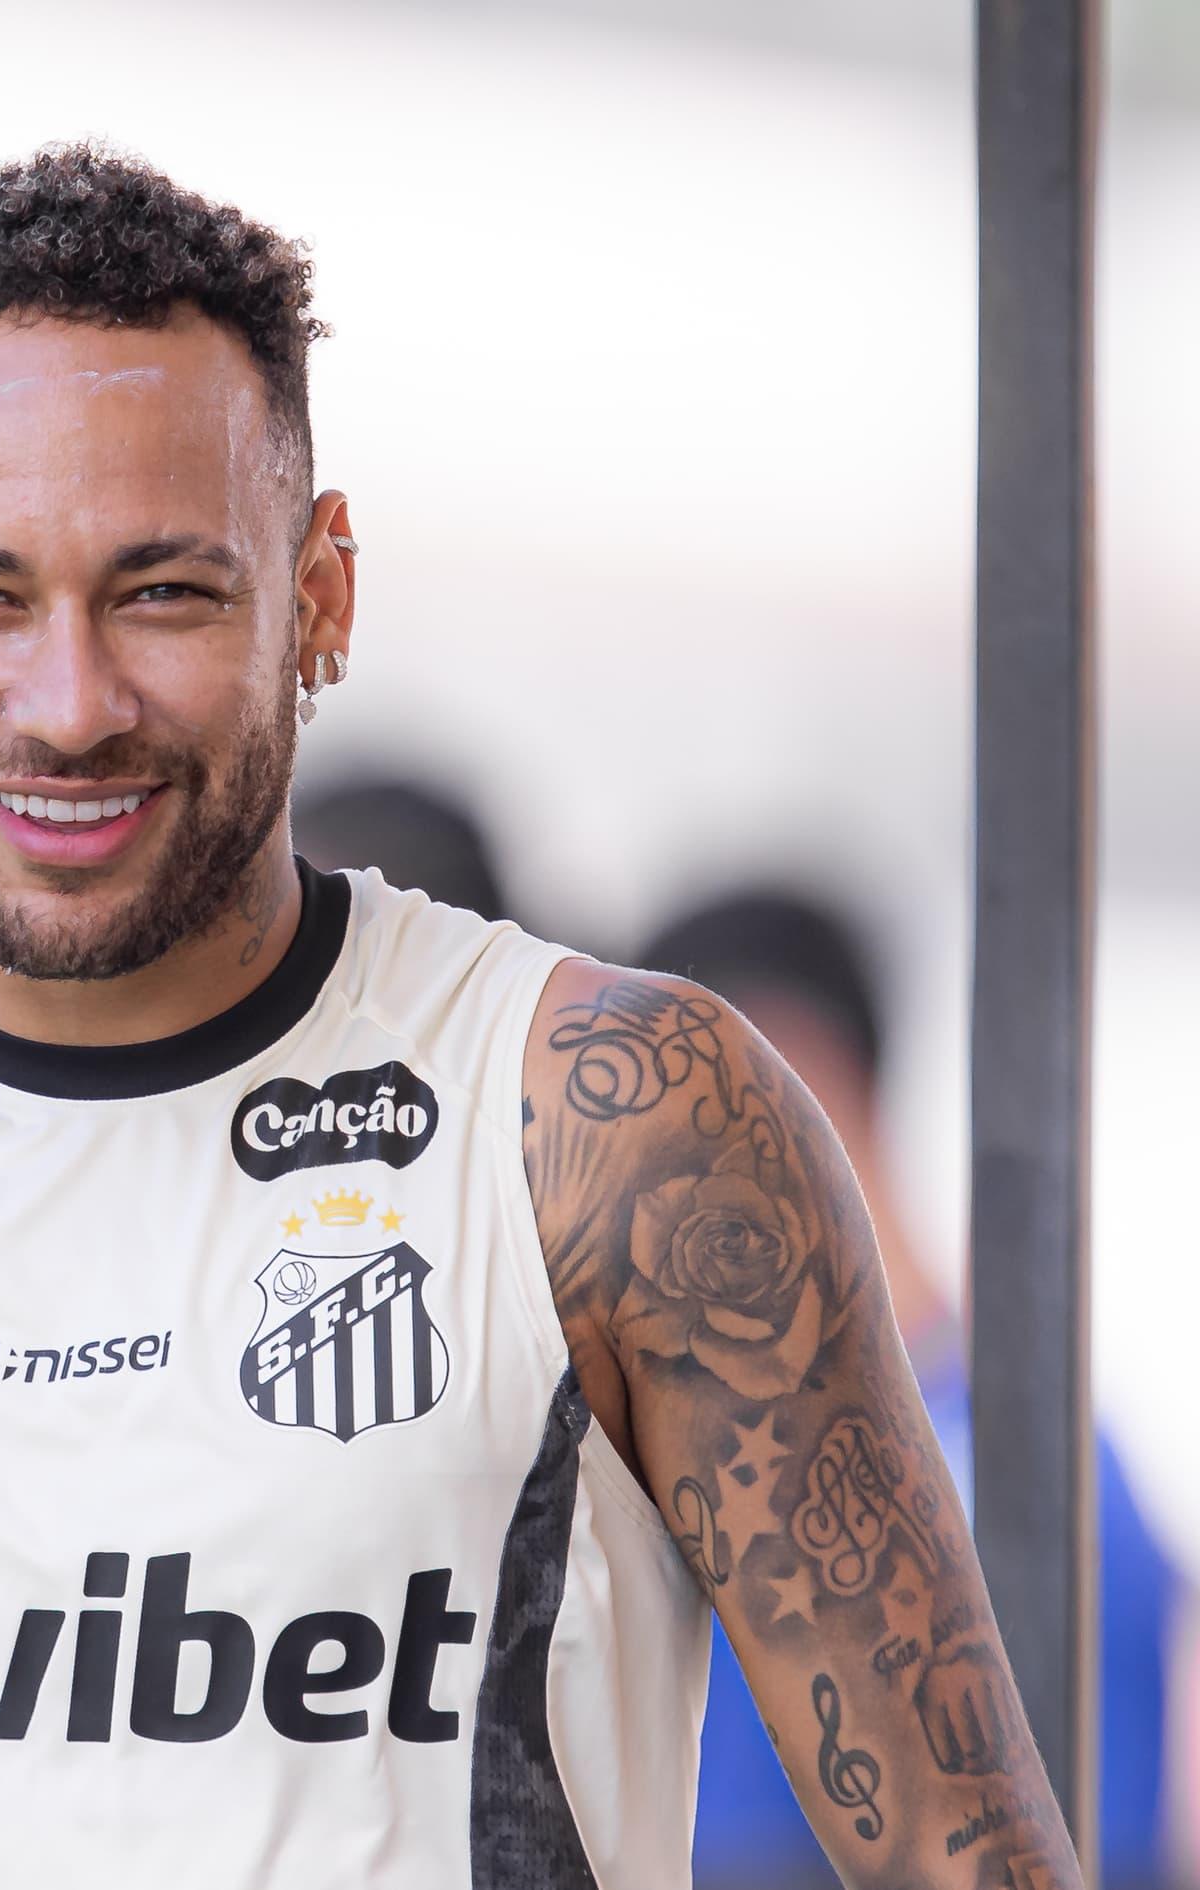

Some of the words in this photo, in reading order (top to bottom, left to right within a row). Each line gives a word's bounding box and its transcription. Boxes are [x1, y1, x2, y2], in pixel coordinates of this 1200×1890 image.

[242, 1083, 428, 1152] Canção
[257, 1255, 412, 1385] S.F.C.
[23, 1330, 173, 1383] nissei
